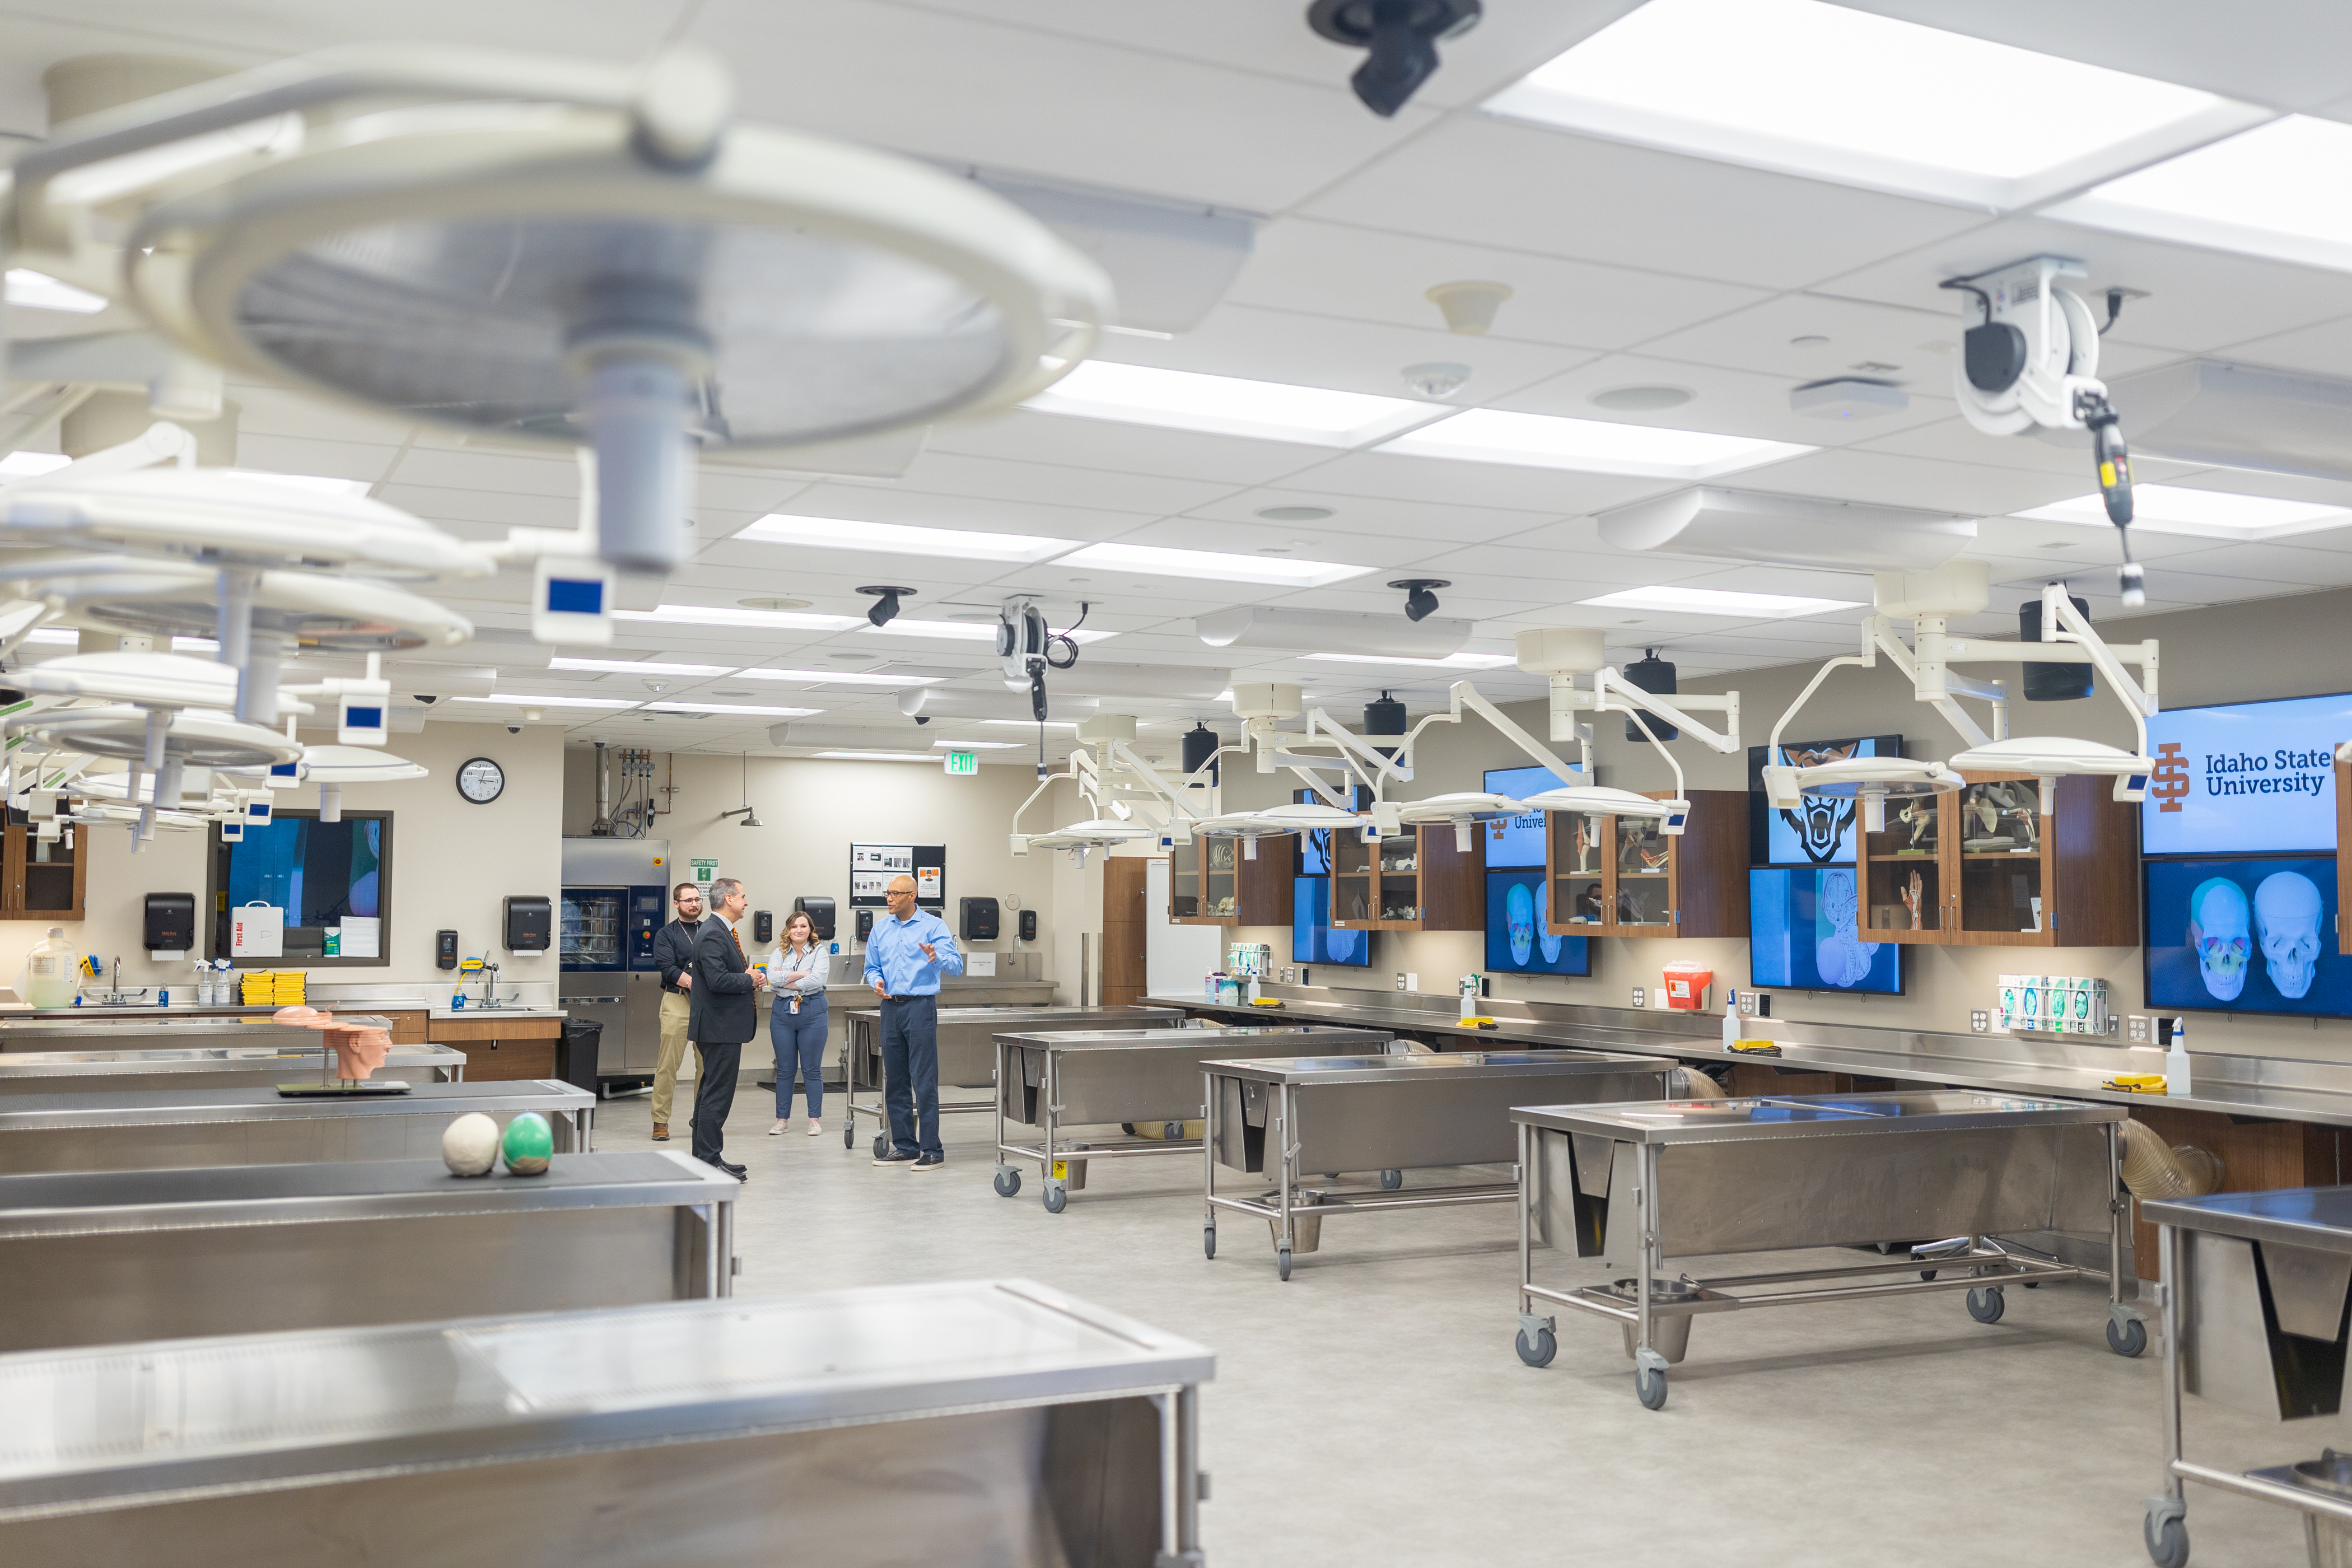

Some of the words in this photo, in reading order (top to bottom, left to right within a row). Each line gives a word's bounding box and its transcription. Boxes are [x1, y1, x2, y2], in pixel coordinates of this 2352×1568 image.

[951, 754, 974, 773] EXIT
[2206, 753, 2267, 774] Idaho
[2274, 749, 2330, 769] State
[2206, 772, 2325, 796] University
[2079, 1023, 2084, 1032] XL
